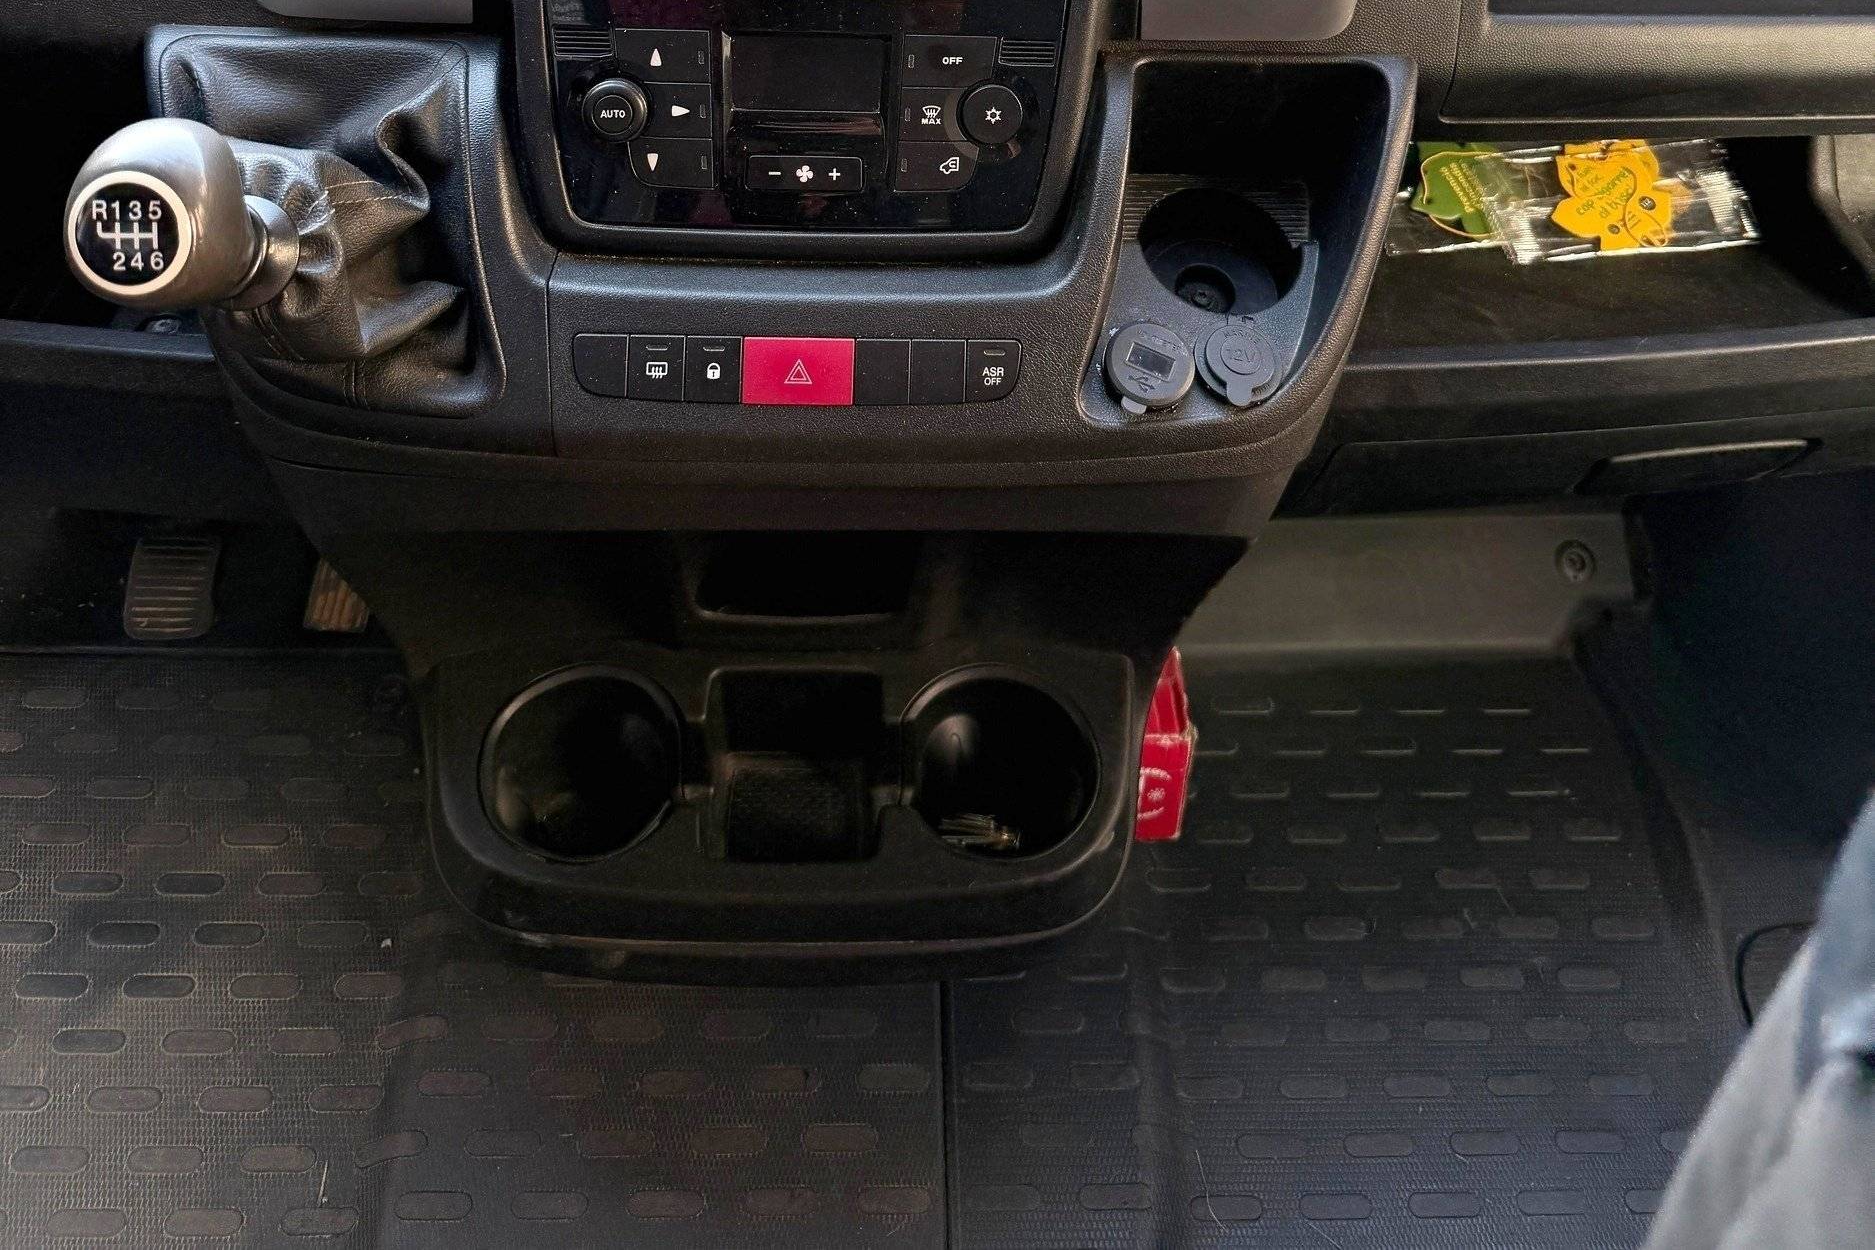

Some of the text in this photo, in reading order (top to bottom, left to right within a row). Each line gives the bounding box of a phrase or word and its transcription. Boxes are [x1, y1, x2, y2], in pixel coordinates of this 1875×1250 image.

[942, 56, 964, 65] OFF
[599, 109, 626, 119] AUTO
[921, 117, 942, 125] MAX
[92, 199, 162, 221] R 1 3 5
[112, 251, 164, 271] 2 4 6
[982, 366, 1005, 377] ASR
[983, 377, 1002, 386] OFF
